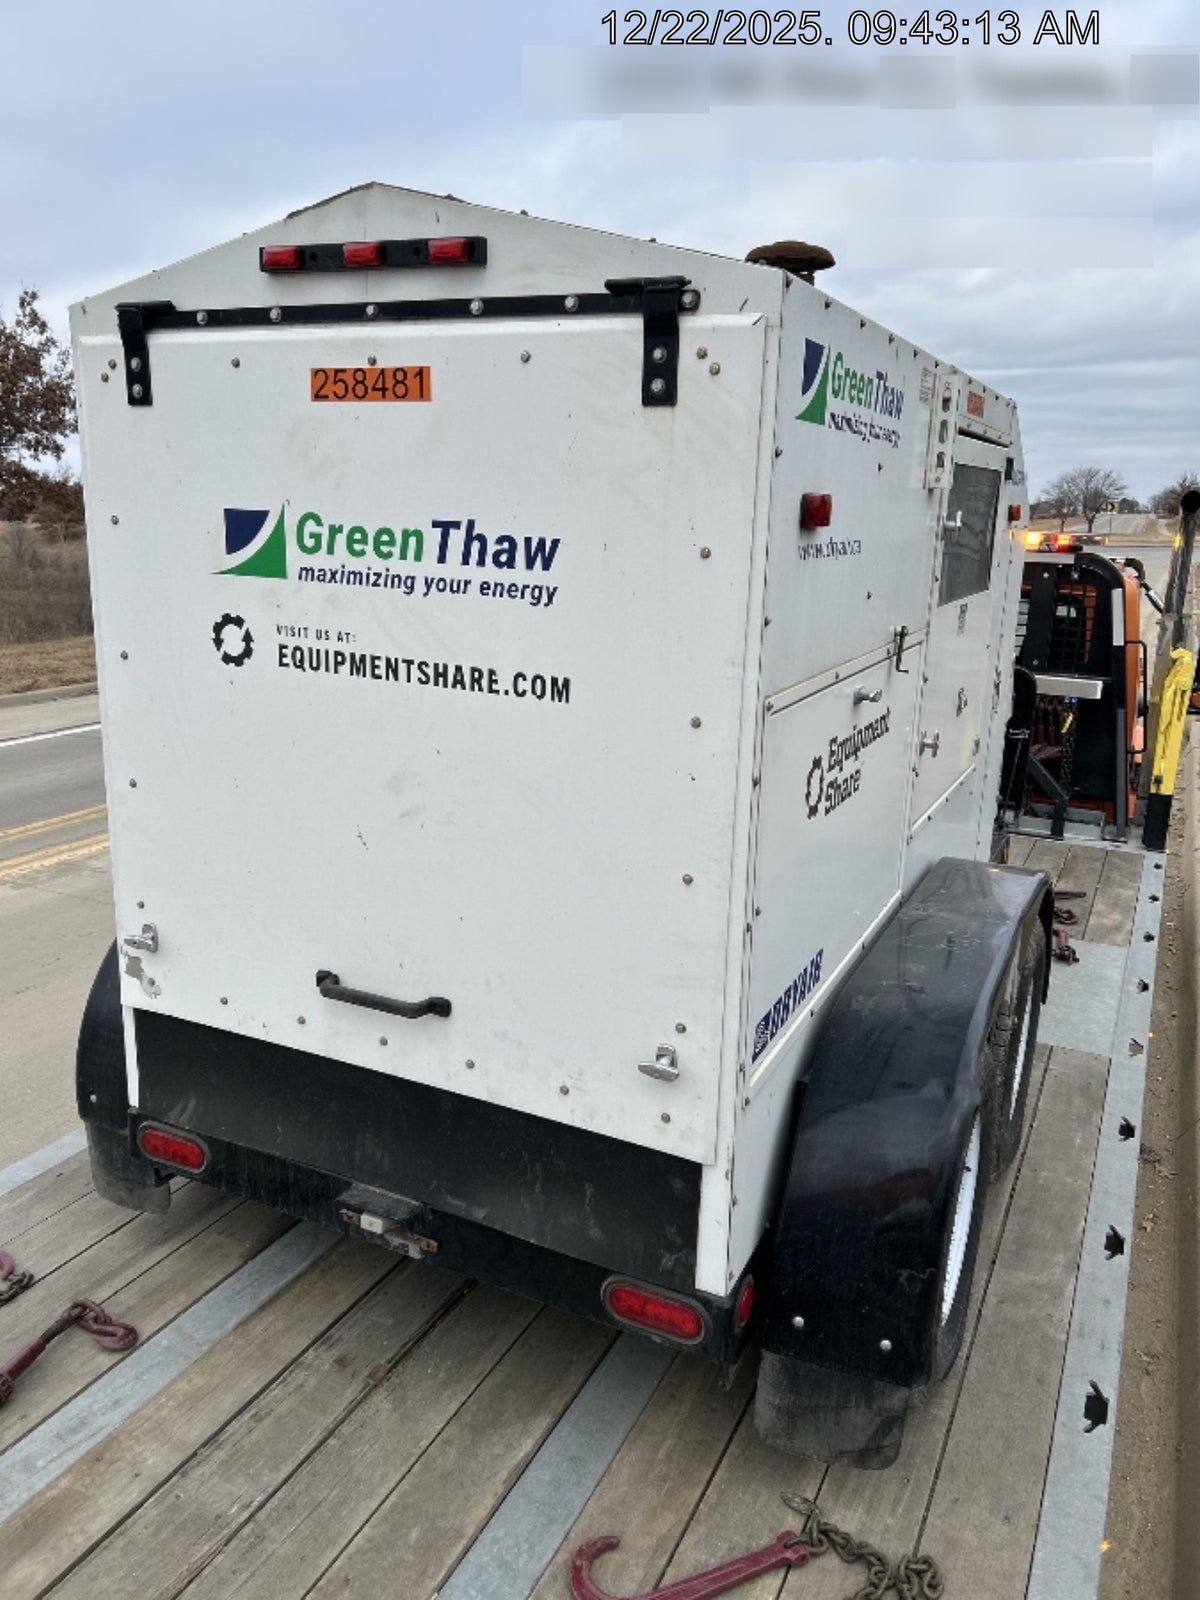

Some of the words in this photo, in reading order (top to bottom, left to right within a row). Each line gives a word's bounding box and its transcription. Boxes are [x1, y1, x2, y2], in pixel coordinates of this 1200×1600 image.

[312, 367, 428, 400] 258481
[298, 564, 416, 595] maximizing
[422, 576, 472, 598] your
[479, 579, 559, 607] energy
[276, 623, 309, 640] VISIT
[315, 629, 330, 642] US
[336, 631, 356, 644] AT:
[277, 643, 571, 704] EQUIPMENTSHARE.COM
[826, 706, 891, 774] Equipment
[824, 768, 862, 817] Share
